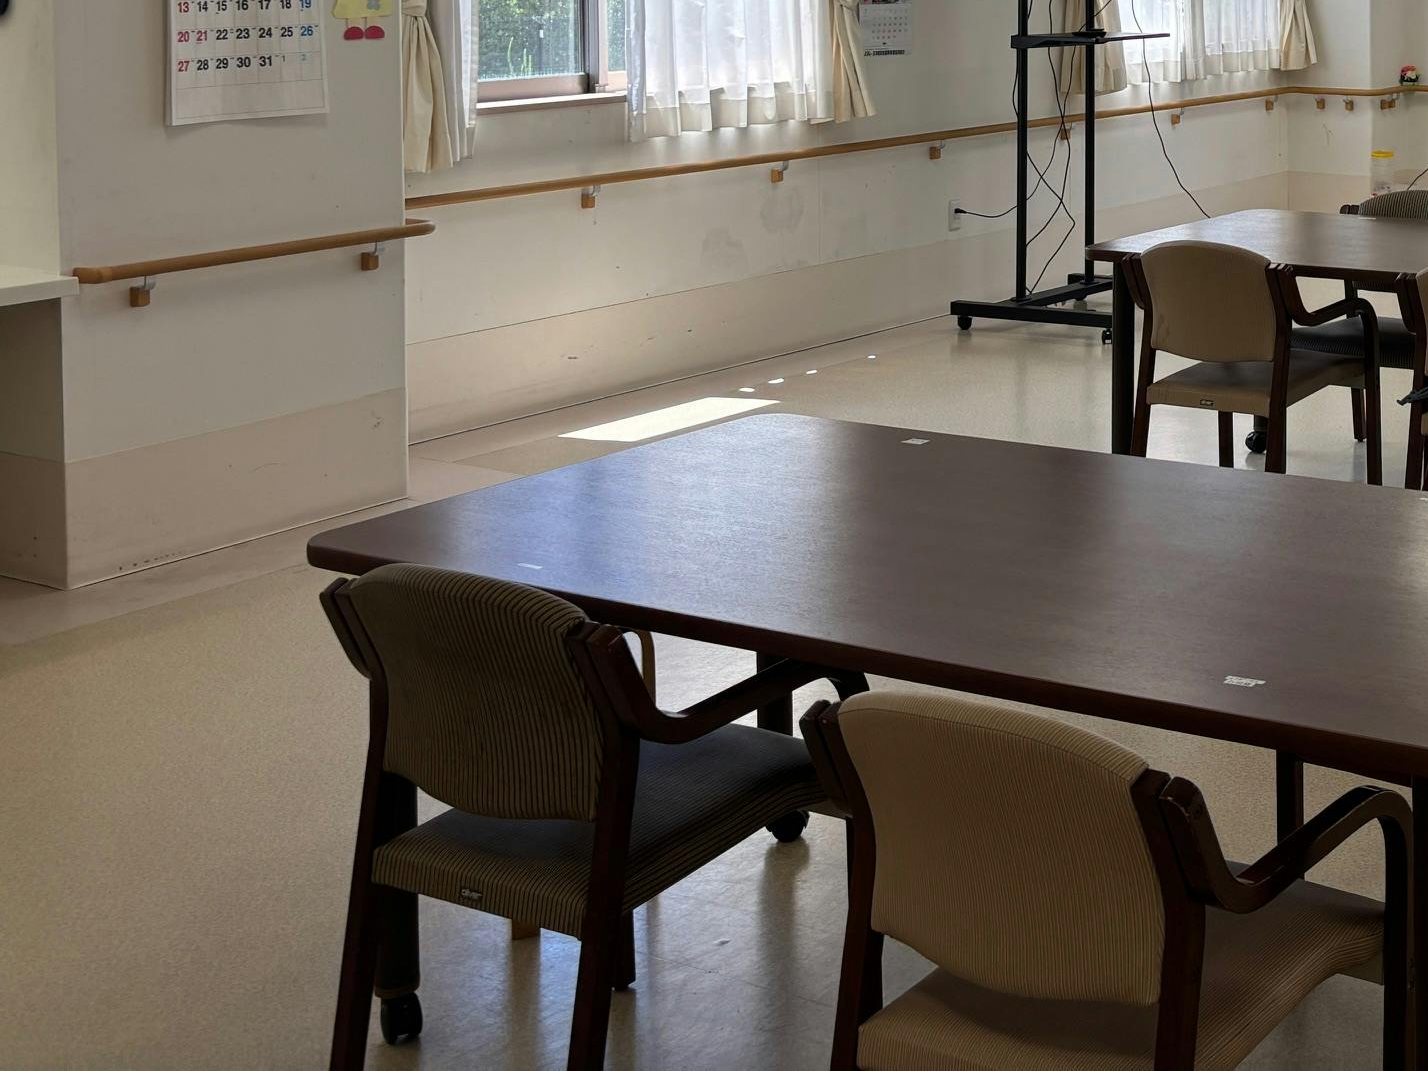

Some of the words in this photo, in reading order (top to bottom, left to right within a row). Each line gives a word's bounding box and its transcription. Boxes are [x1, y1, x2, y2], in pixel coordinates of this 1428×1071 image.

[178, 2, 189, 13] 13
[197, 1, 208, 12] 14
[216, 1, 227, 11] 15
[236, 0, 248, 10] 16
[258, 0, 271, 9] 17
[280, 0, 291, 9] 18
[178, 31, 189, 42] 20
[197, 31, 207, 41] 21
[216, 29, 228, 40] 22
[236, 28, 249, 39] 23
[259, 28, 272, 38] 24
[281, 27, 293, 37] 25
[301, 26, 313, 36] 26
[178, 61, 189, 72] 27
[197, 60, 209, 70] 28
[216, 58, 229, 69] 29
[237, 57, 251, 68] 30
[260, 56, 272, 66] 31
